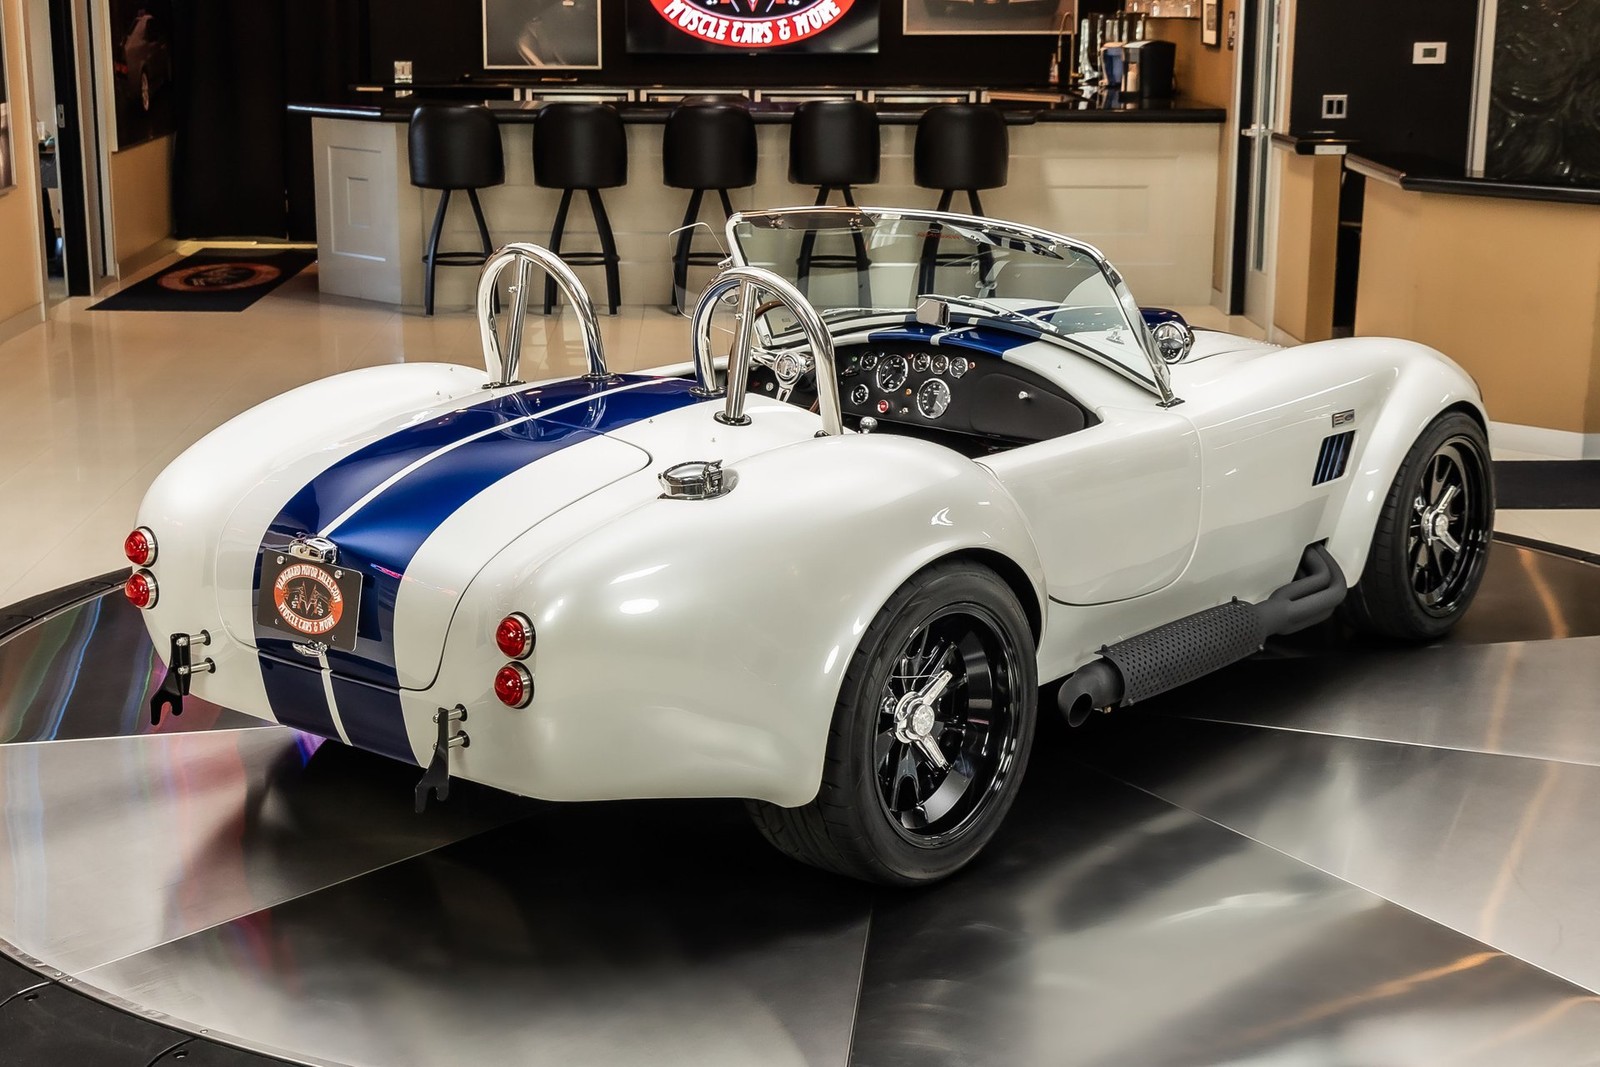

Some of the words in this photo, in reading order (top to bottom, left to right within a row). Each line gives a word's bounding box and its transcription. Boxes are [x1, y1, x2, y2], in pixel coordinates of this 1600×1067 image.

[663, 1, 729, 41] MUSCLE
[731, 21, 773, 44] CARS
[778, 20, 791, 41] &
[795, 1, 841, 36] MORE
[276, 565, 301, 590] VANGUARD
[301, 565, 318, 577] MOTOR
[318, 570, 341, 603] SALES.COM
[278, 603, 298, 627] MUSCLE
[298, 620, 313, 632] CARS
[313, 622, 319, 632] &
[319, 614, 335, 632] MORE
